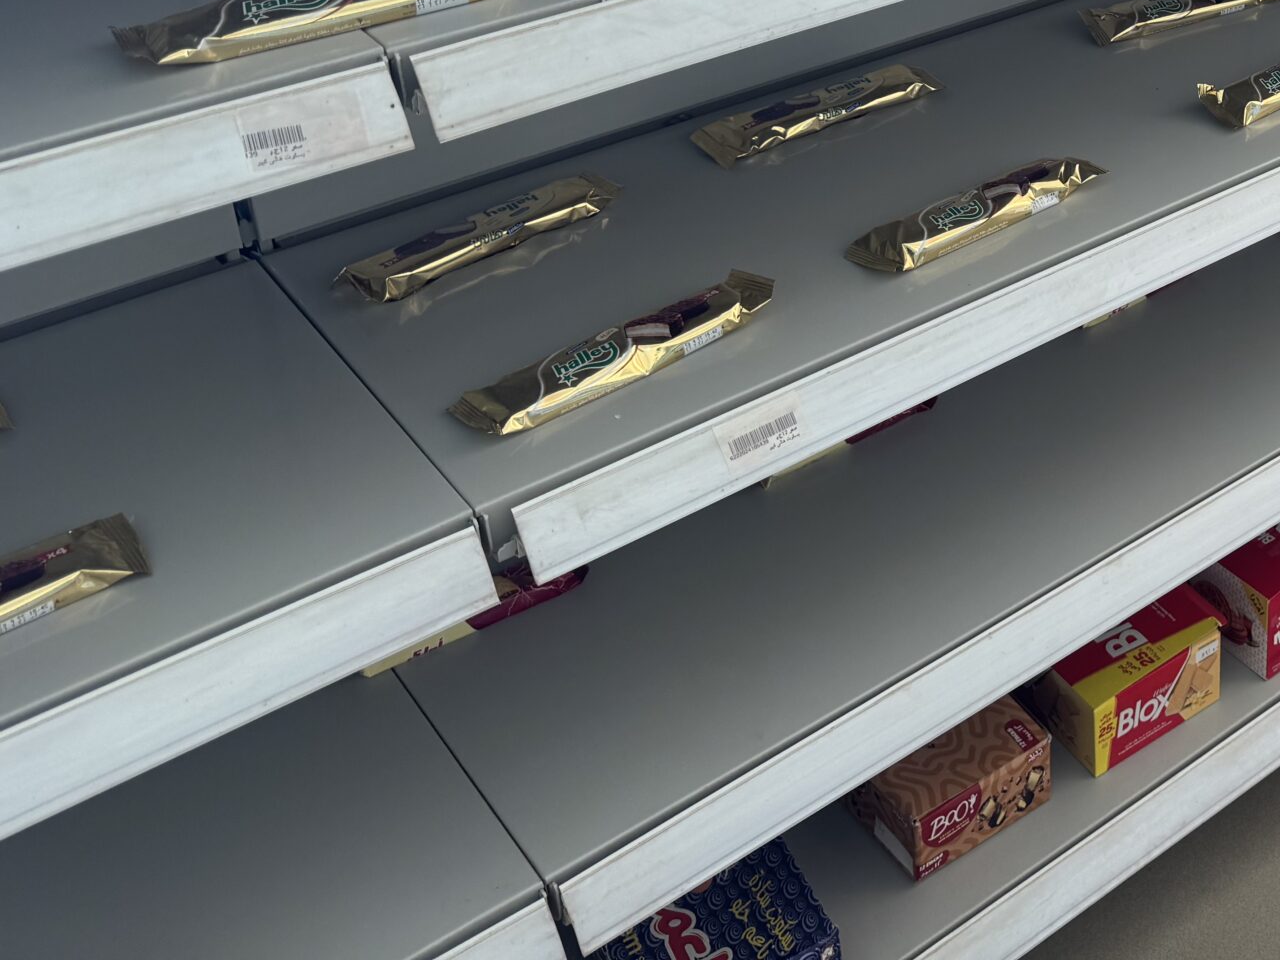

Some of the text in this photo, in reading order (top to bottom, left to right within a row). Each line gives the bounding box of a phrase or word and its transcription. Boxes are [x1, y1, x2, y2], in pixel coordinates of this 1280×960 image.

[929, 199, 984, 224] halley
[552, 339, 619, 378] halley
[1116, 693, 1171, 739] Blox
